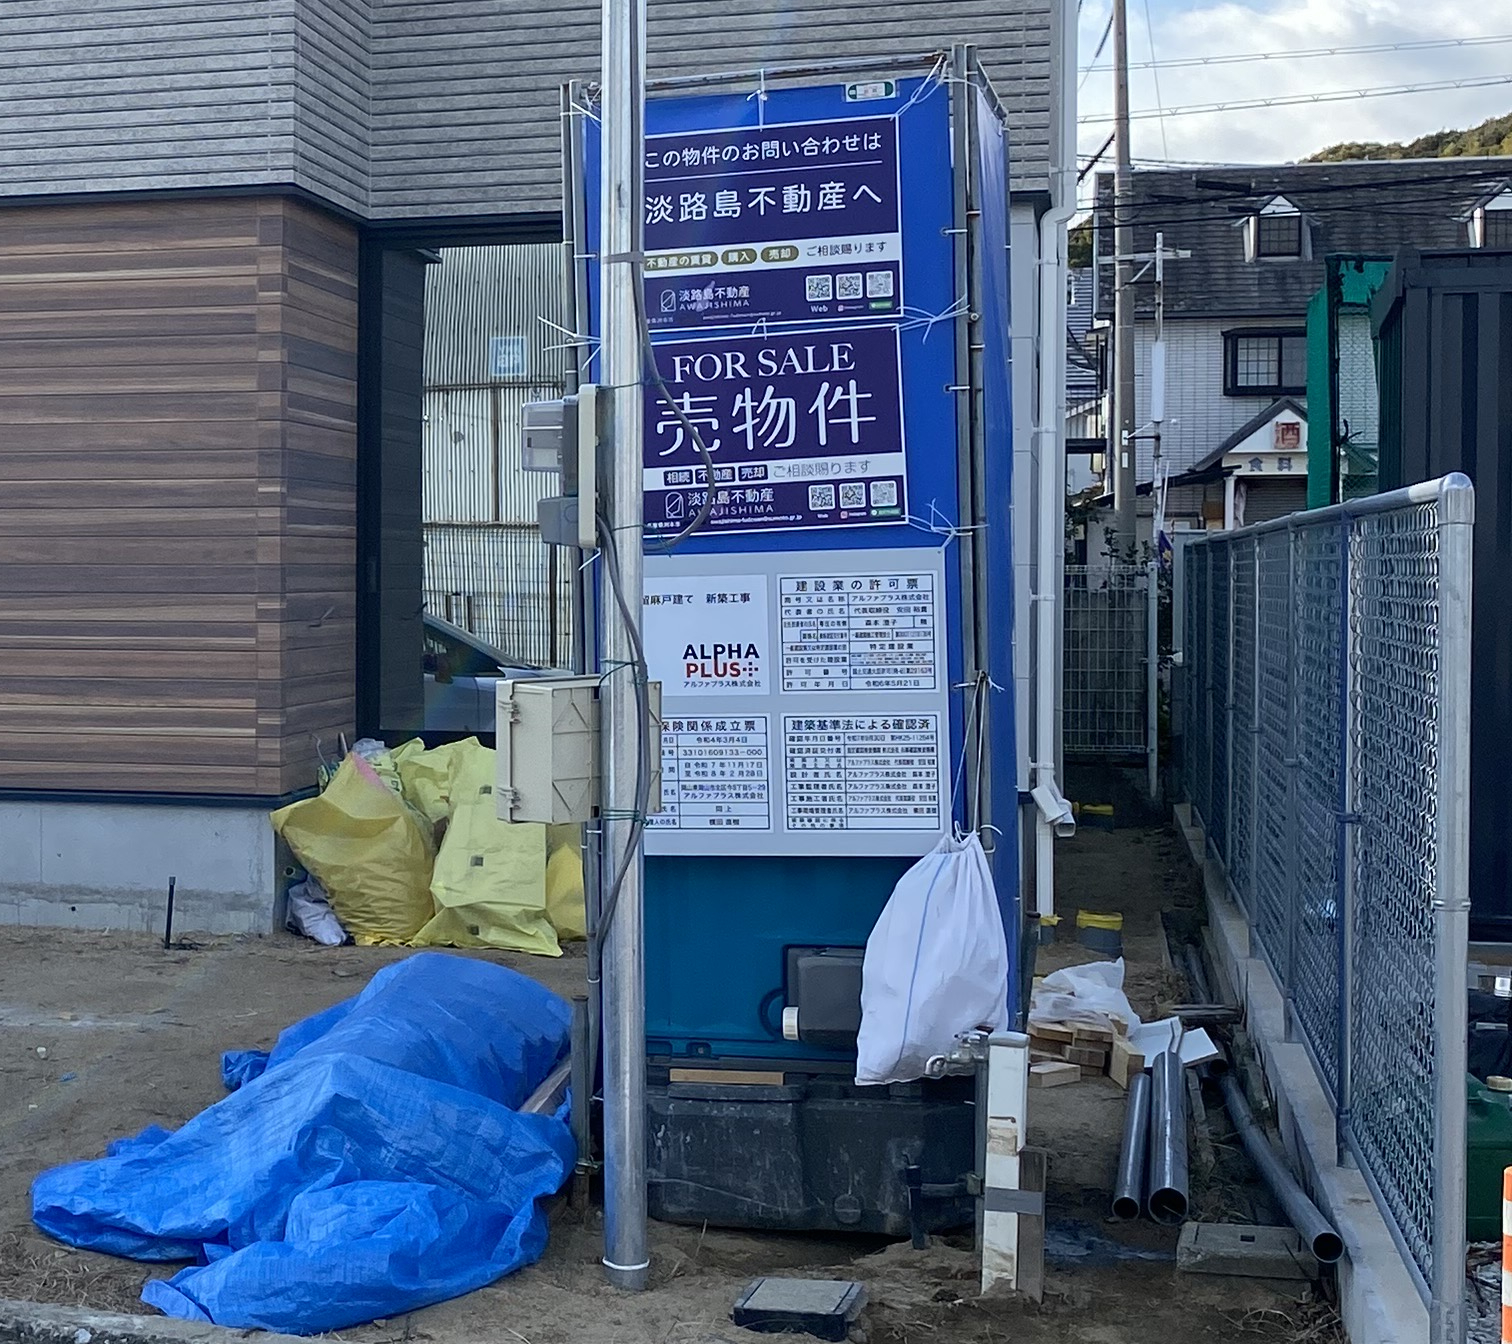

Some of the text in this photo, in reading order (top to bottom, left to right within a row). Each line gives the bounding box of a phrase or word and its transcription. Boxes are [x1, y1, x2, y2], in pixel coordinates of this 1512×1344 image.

[644, 132, 883, 168] この物件のお問い合わせは
[644, 180, 883, 224] 淡路島不動産へ
[807, 241, 887, 256] ご相談賜ります
[679, 285, 750, 302] 淡路島不動産
[679, 299, 750, 311] AWAJISHIMA
[810, 304, 829, 313] Web
[672, 343, 856, 383] FOR SALE
[656, 379, 877, 456] 売物件
[773, 459, 871, 478] ご相談賜ります
[688, 504, 774, 517] AAJISHIMA
[795, 578, 919, 592] 建設業の許可票
[705, 592, 751, 604] 新築工事
[682, 643, 760, 660] ALPHA
[683, 680, 762, 688] アルファプラス株式会社
[791, 718, 930, 731] 建築基準法による確認済
[683, 792, 764, 800] アルファプラス株式会社
